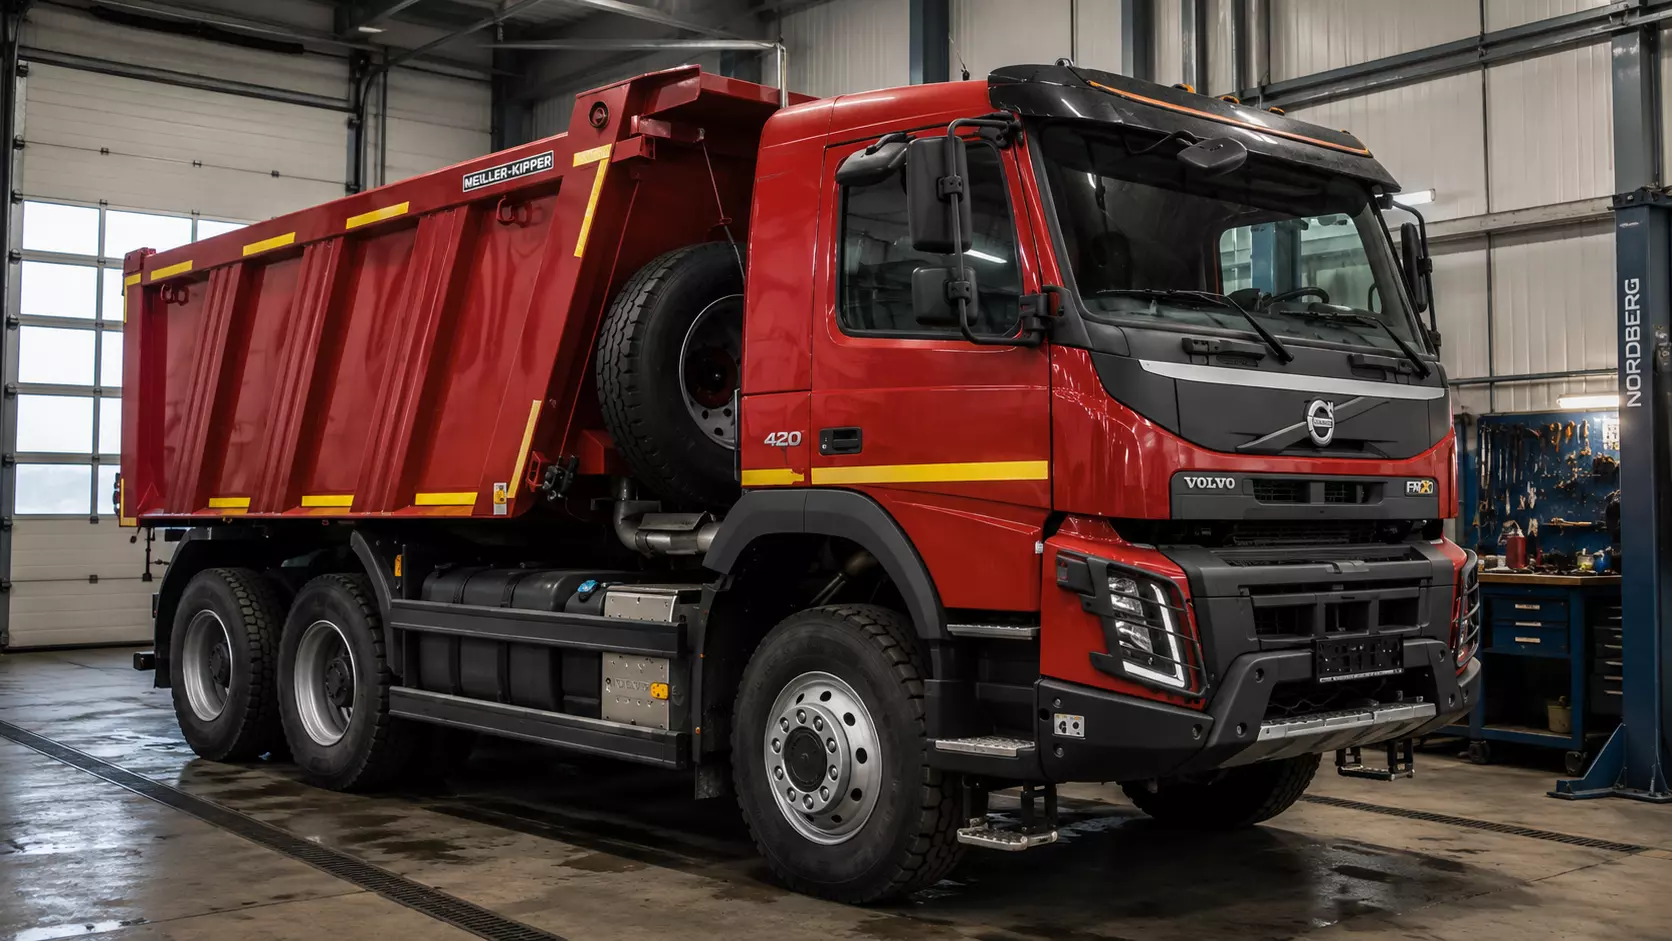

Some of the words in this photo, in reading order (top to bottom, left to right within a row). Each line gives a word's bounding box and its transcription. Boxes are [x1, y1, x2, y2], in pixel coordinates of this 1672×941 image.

[1624, 278, 1642, 407] NORDBERG
[763, 431, 802, 447] 420
[1183, 476, 1236, 489] VOLVO
